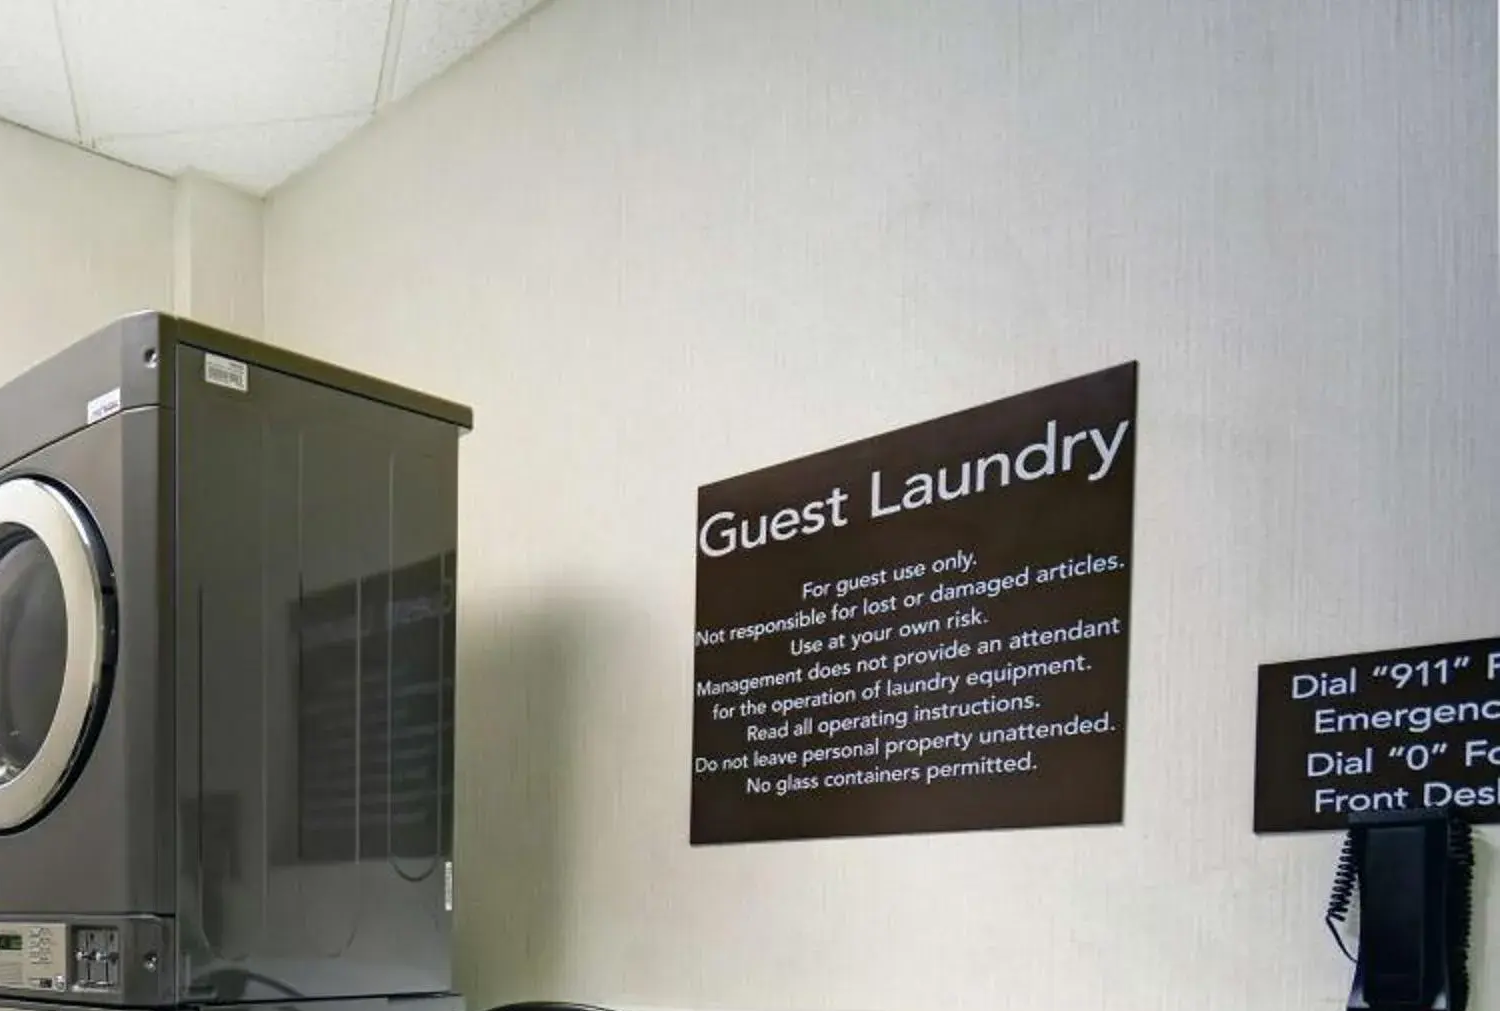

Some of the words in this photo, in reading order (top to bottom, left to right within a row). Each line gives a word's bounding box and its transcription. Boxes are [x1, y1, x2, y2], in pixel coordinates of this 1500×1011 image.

[699, 487, 849, 558] Guest
[871, 419, 1130, 518] Laundry
[695, 630, 726, 647] Not
[729, 609, 827, 641] responsible
[831, 603, 858, 622] for
[863, 594, 897, 616] lost
[903, 592, 927, 608] or
[930, 567, 1030, 604] damaged
[1036, 553, 1126, 583] articles.
[803, 581, 831, 600] For
[836, 570, 888, 597] guest
[893, 563, 926, 582] use
[932, 550, 978, 574] only.
[696, 668, 803, 696] Management
[807, 662, 852, 681] does
[857, 654, 888, 673] not
[893, 639, 971, 672] provide
[977, 638, 1002, 655] an
[1008, 616, 1122, 650] attendant
[790, 639, 824, 656] Use
[828, 635, 846, 650] at
[851, 626, 893, 651] your
[899, 618, 940, 638] own
[946, 606, 989, 629] risk.
[712, 703, 736, 720] for
[740, 699, 767, 716] the
[771, 688, 857, 715] operation
[861, 679, 883, 700] of
[886, 672, 960, 696] laundry
[965, 654, 1092, 686] equipment.
[1291, 666, 1357, 700] Dial
[695, 757, 718, 773] Do
[722, 755, 749, 770] not
[752, 750, 798, 768] leave
[802, 738, 879, 767] personal
[885, 729, 972, 760] property
[979, 711, 1117, 745] unattended.
[746, 721, 789, 742] Read
[793, 718, 813, 737] all
[817, 709, 908, 738] operating
[914, 694, 1041, 722] instructions.
[746, 777, 771, 795] No
[775, 774, 820, 796] glass
[823, 765, 921, 788] containers
[926, 751, 1038, 784] permitted.
[1307, 747, 1373, 778] Dial
[1315, 787, 1409, 813] Front
[1423, 777, 1500, 808] Des
